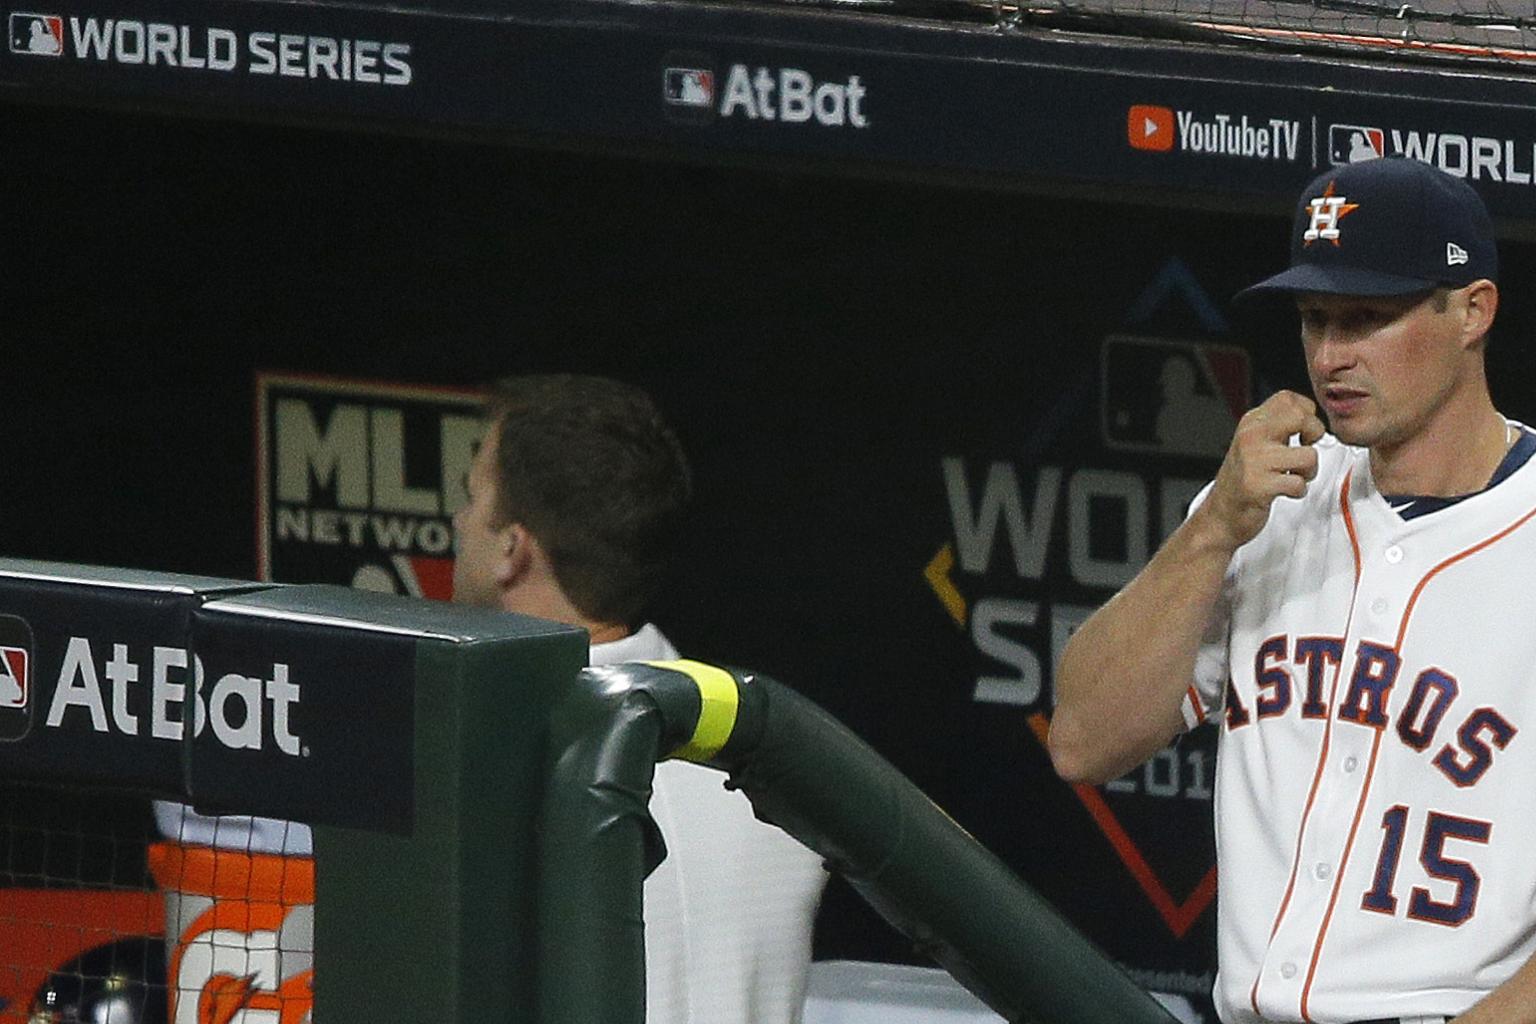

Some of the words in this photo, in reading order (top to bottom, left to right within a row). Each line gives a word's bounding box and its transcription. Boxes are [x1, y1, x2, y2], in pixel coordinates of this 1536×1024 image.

[70, 17, 238, 71] WORLD
[248, 32, 413, 86] SERIES
[276, 508, 454, 555] NETWO
[1361, 804, 1494, 929] 15
